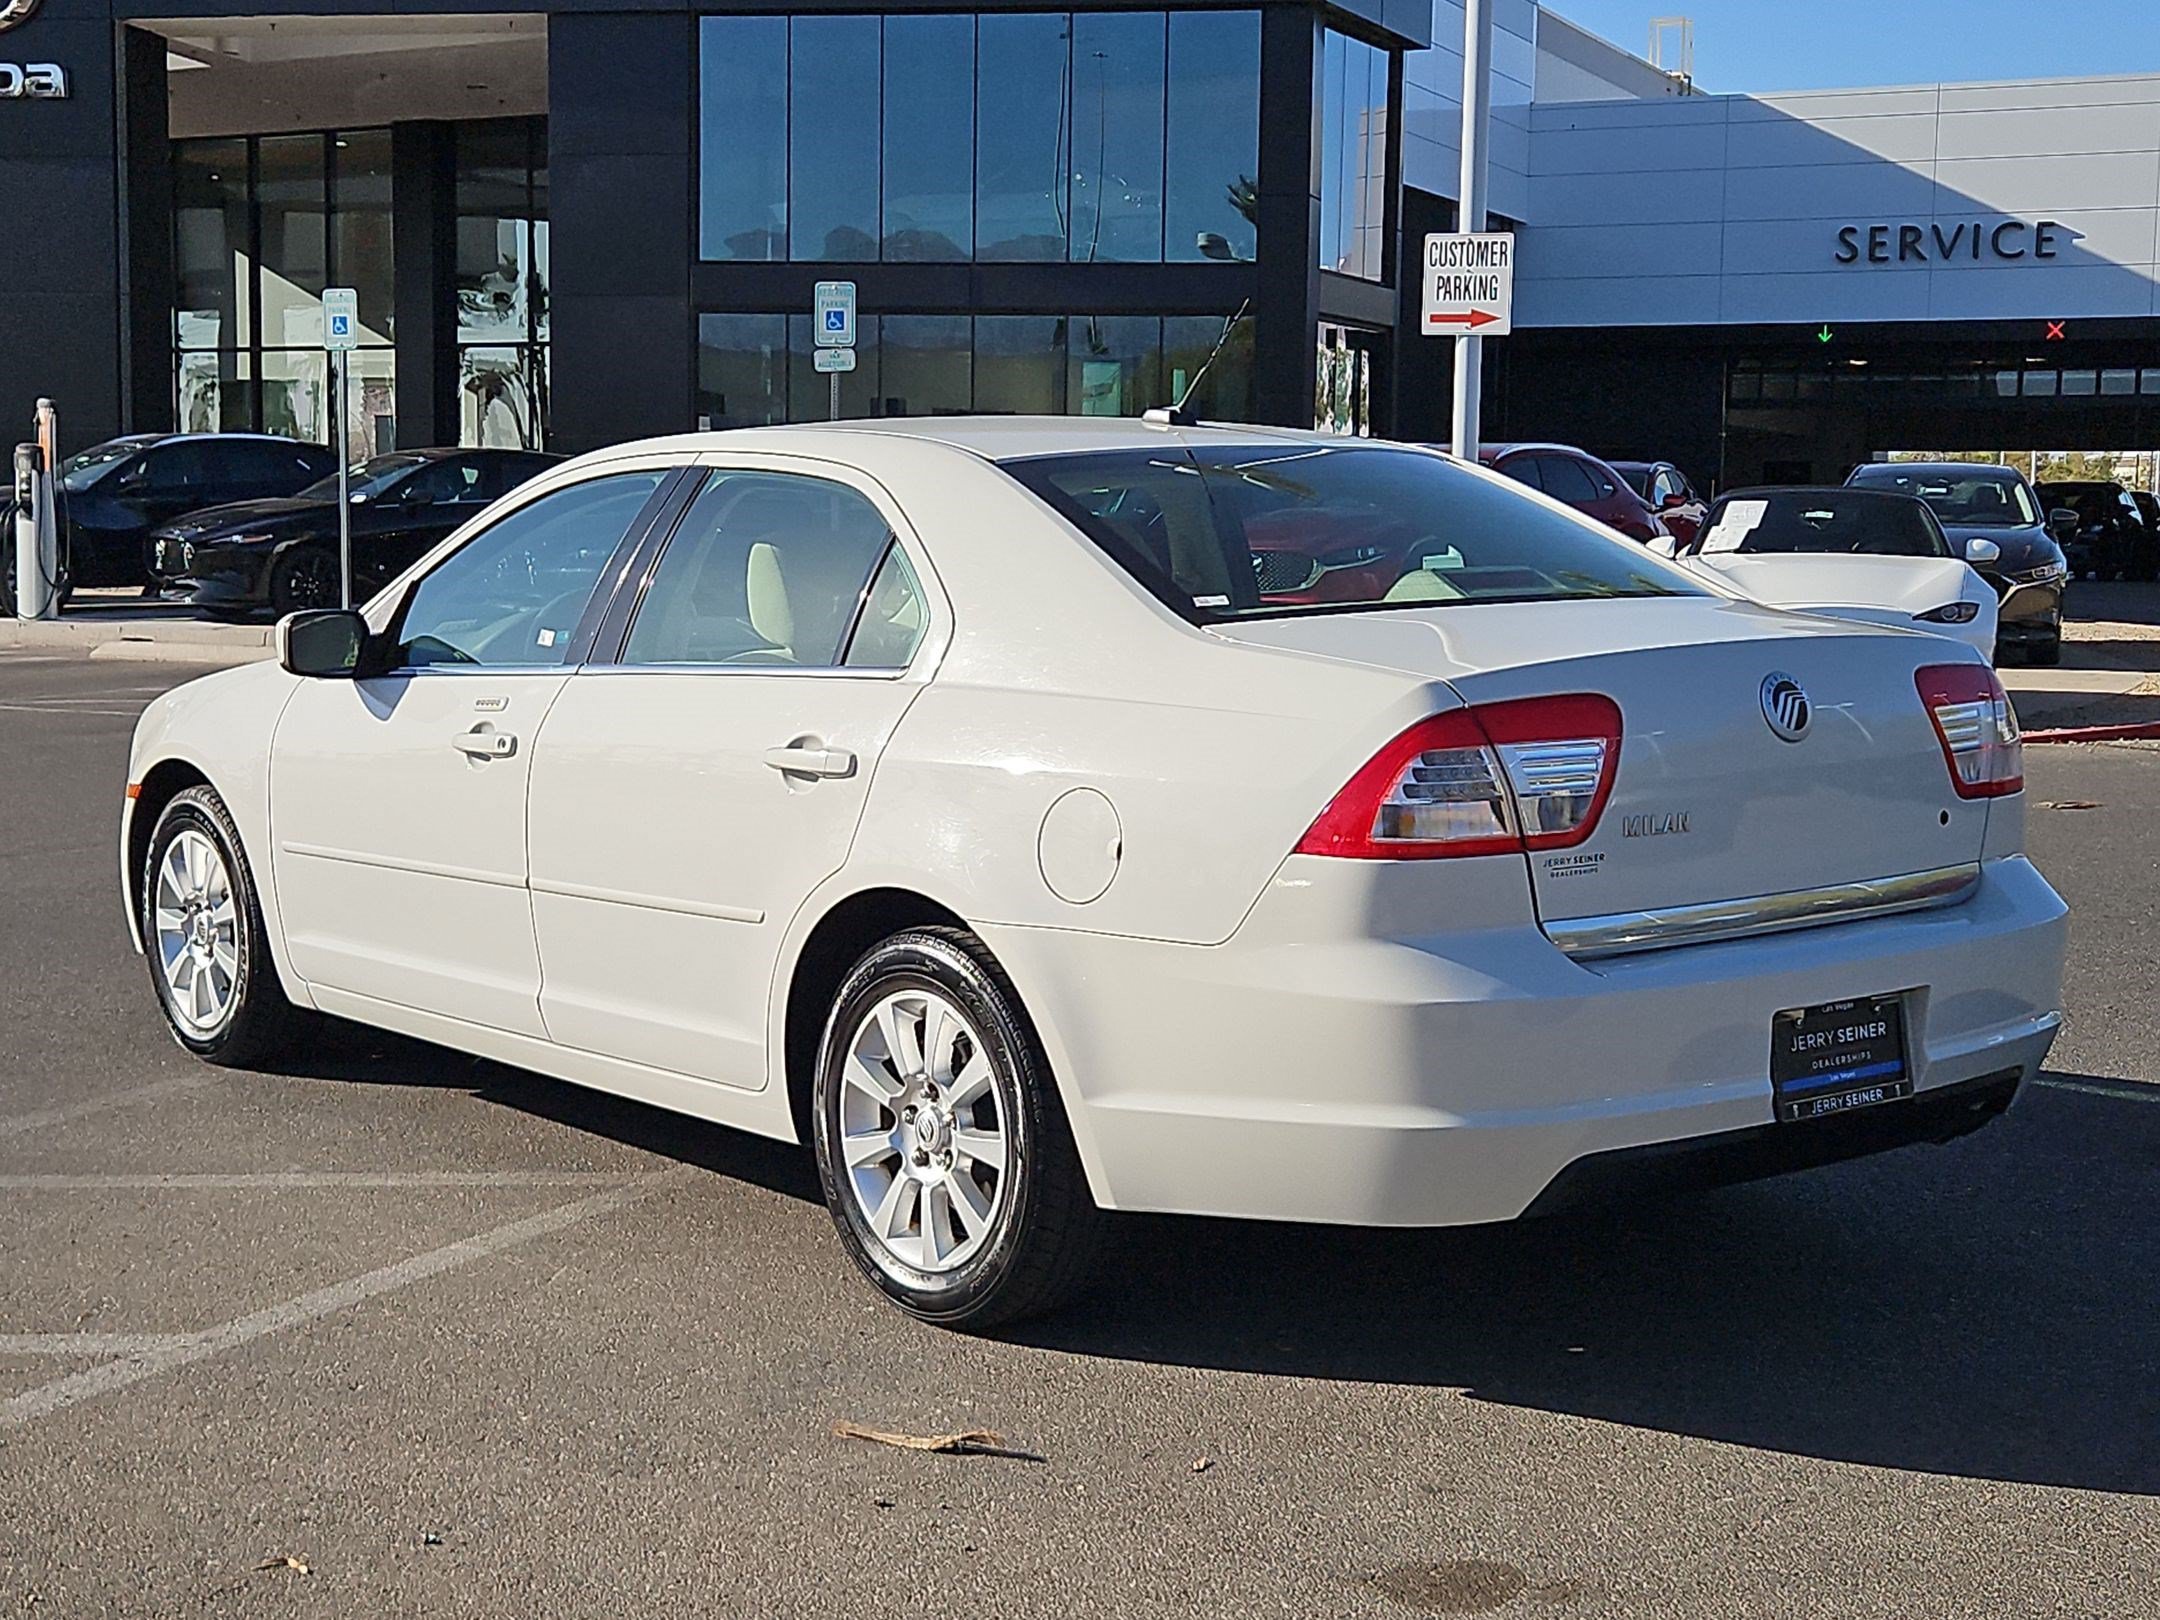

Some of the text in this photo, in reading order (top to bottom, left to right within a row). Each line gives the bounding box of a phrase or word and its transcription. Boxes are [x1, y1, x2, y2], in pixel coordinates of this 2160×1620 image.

[1429, 240, 1508, 268] CUSTOMER
[1835, 221, 2057, 263] SERVICE
[1436, 274, 1499, 301] PARKING
[1622, 811, 1690, 838] MILAN
[1543, 853, 1606, 868] JERRY SEINER
[1550, 867, 1599, 878] DEALERSHIPS
[1791, 1021, 1887, 1052] JERRY SEINER
[1811, 1051, 1872, 1070] DEALERSHIPS
[1811, 1088, 1884, 1114] JERRY SEINER
